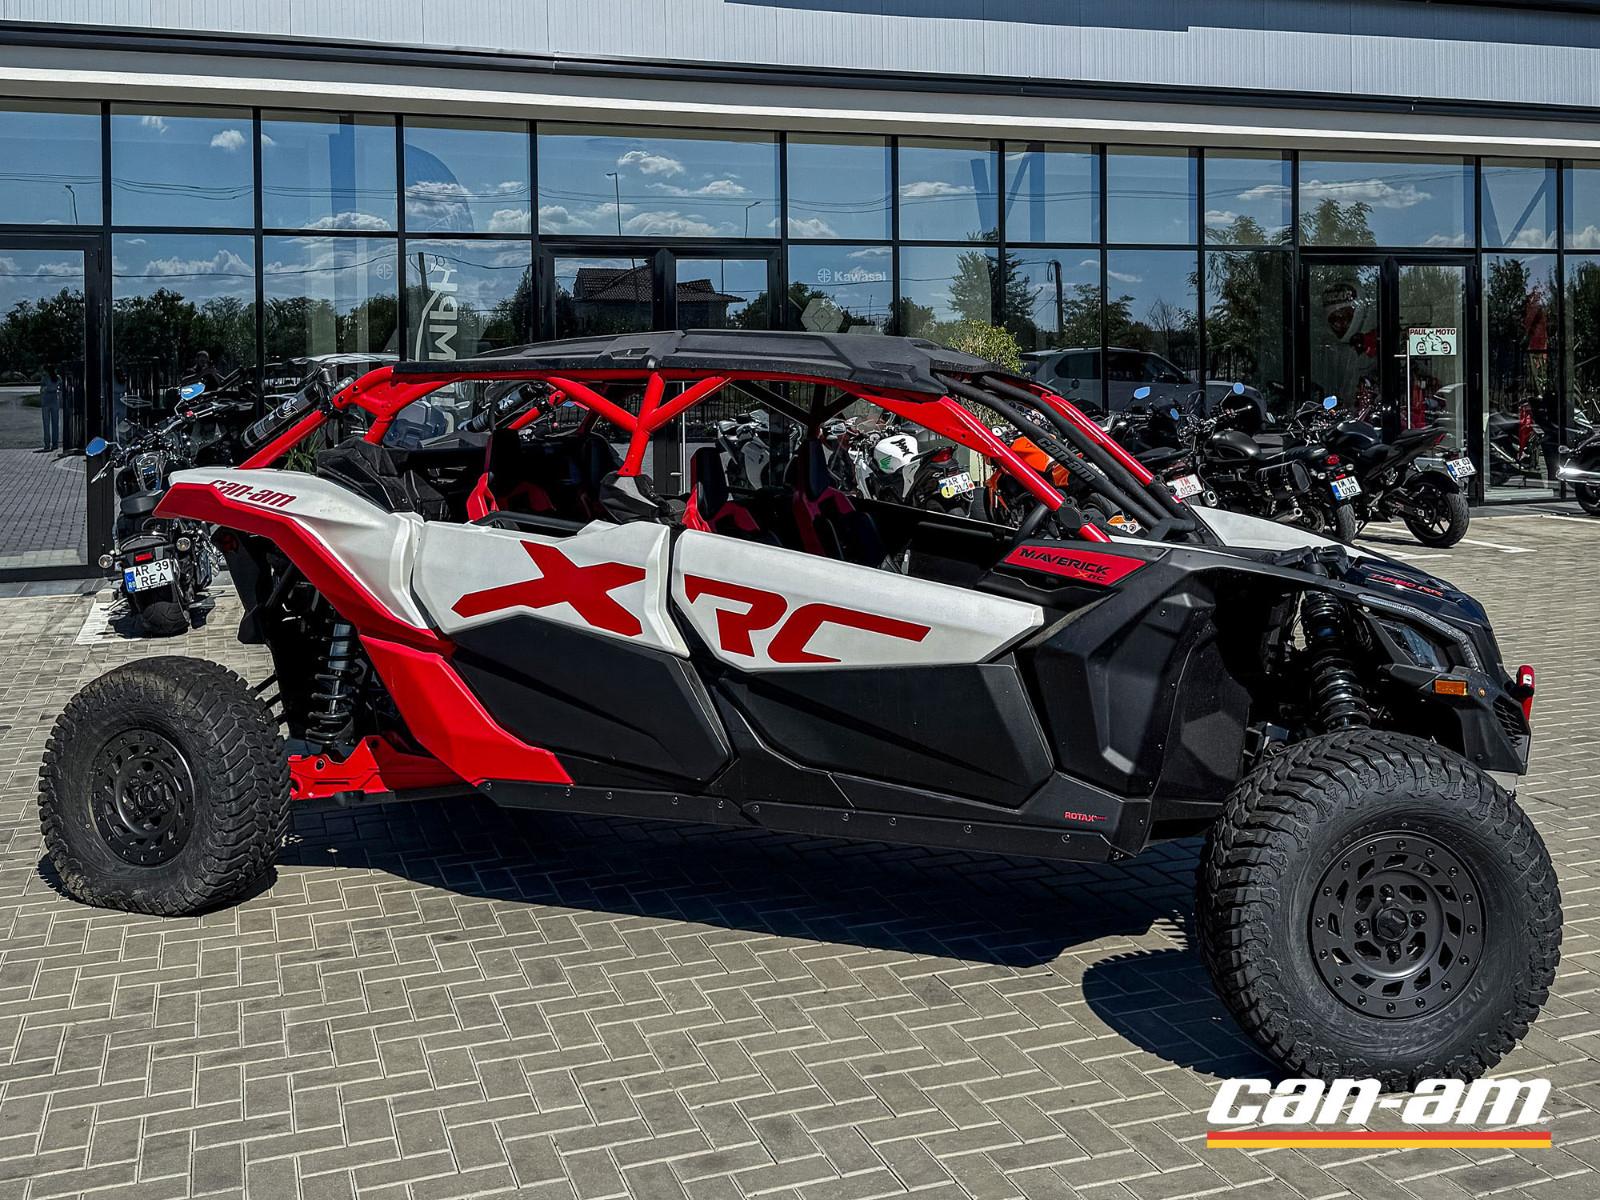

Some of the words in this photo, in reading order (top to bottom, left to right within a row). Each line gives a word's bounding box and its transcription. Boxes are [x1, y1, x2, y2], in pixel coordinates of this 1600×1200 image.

[209, 480, 297, 507] can-am
[135, 565, 149, 578] AR
[155, 560, 169, 572] 39
[1020, 548, 1111, 576] MAVERICK
[140, 573, 168, 587] REA
[1064, 811, 1094, 822] ROTAX
